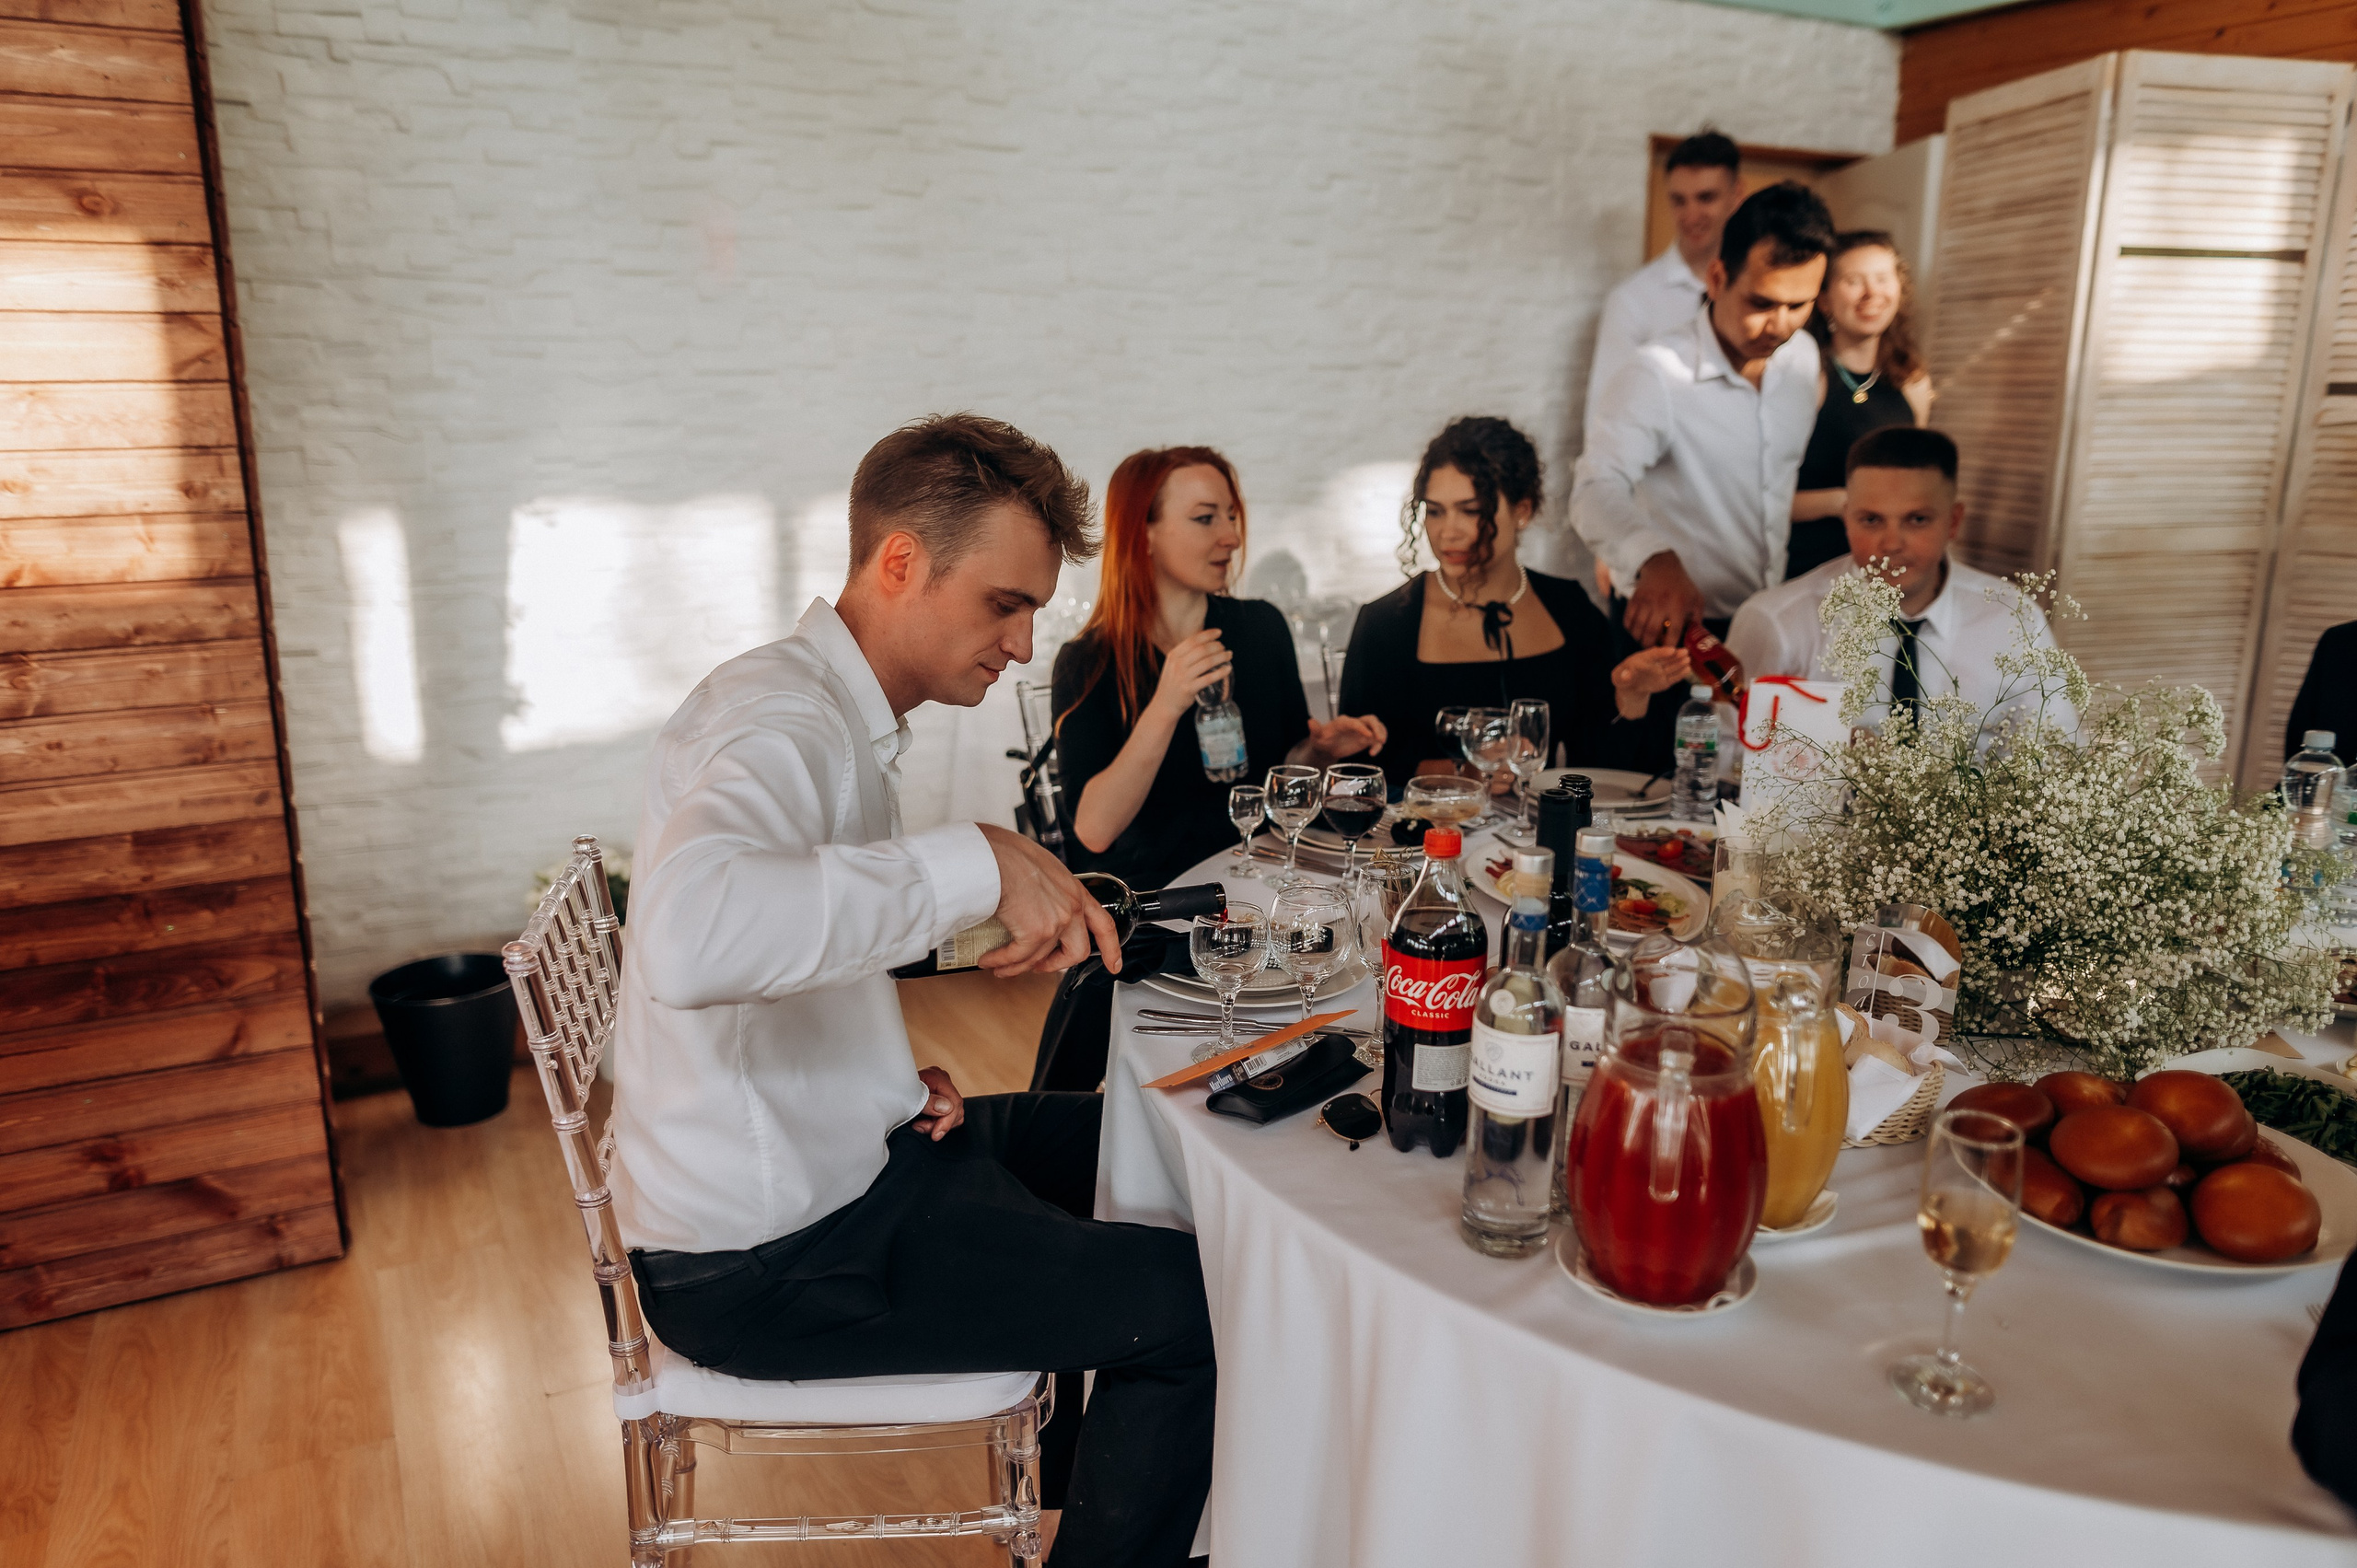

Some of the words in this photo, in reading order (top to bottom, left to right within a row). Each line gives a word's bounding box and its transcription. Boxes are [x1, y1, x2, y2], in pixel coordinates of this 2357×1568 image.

[1386, 965, 1481, 1010] Coca-Cola
[1411, 1009, 1450, 1019] CLASSIC
[1880, 973, 1943, 1042] 3
[1208, 1074, 1234, 1091] Marlboro
